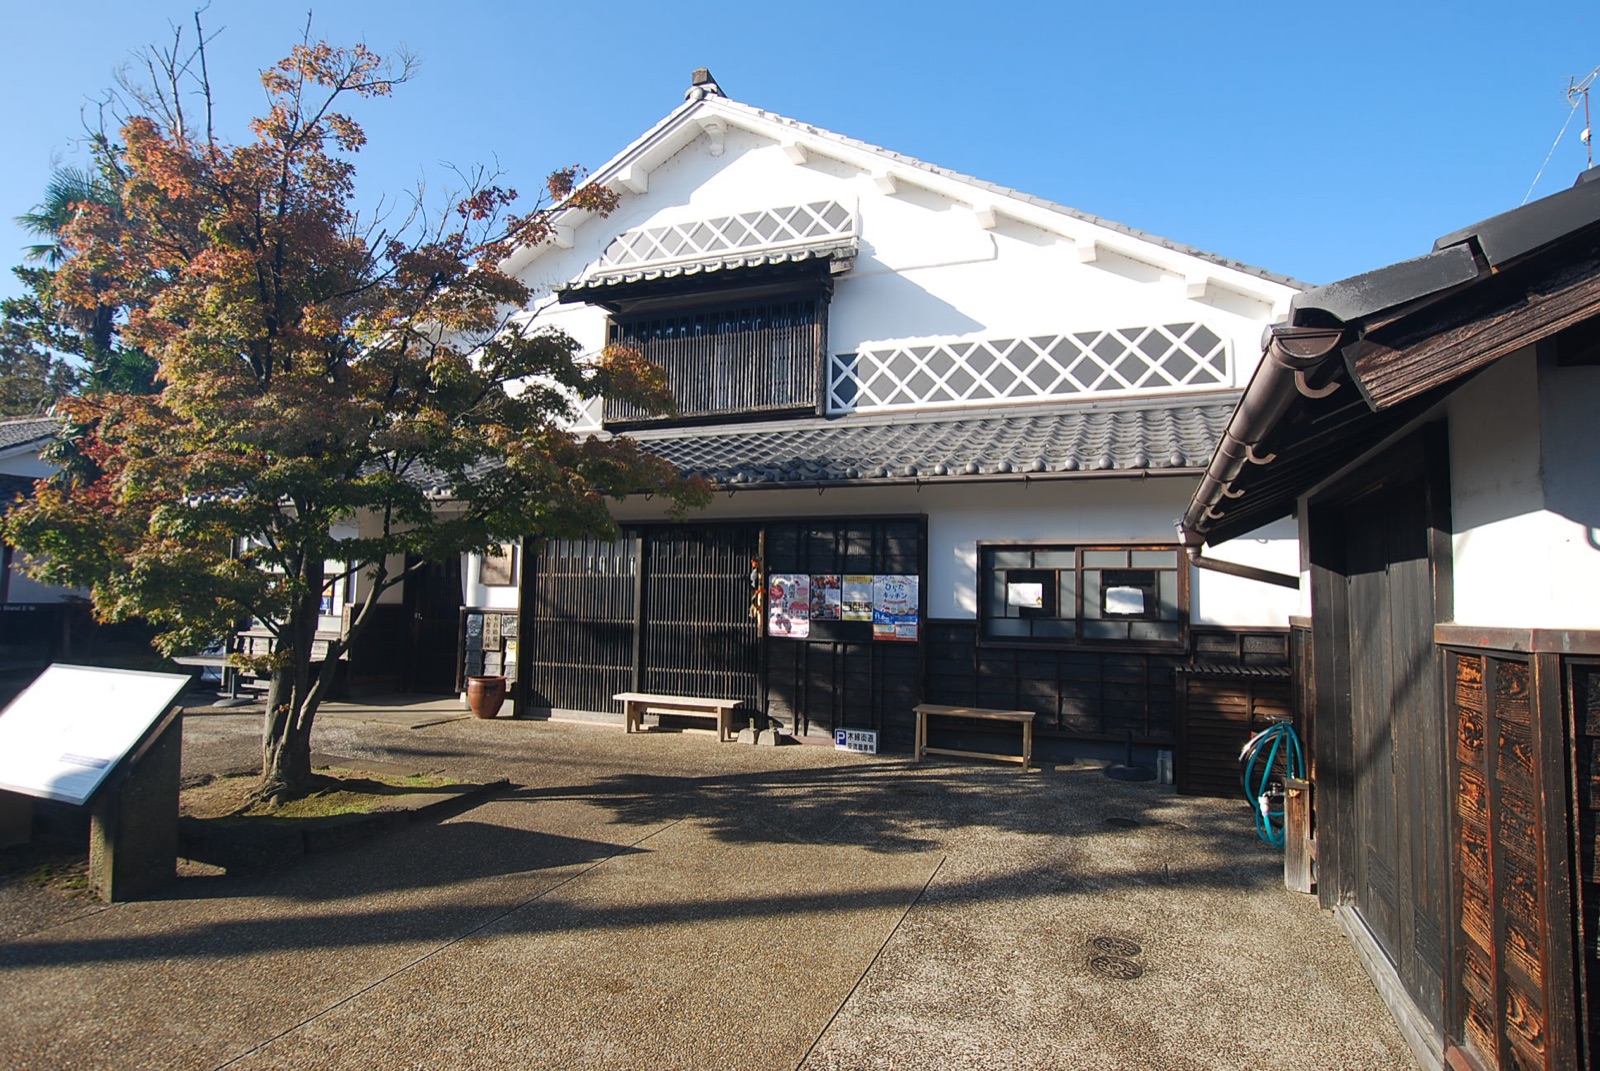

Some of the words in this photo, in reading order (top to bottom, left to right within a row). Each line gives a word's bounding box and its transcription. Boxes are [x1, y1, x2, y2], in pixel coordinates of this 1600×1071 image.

[885, 583, 905, 592] ひらた
[836, 731, 846, 744] P
